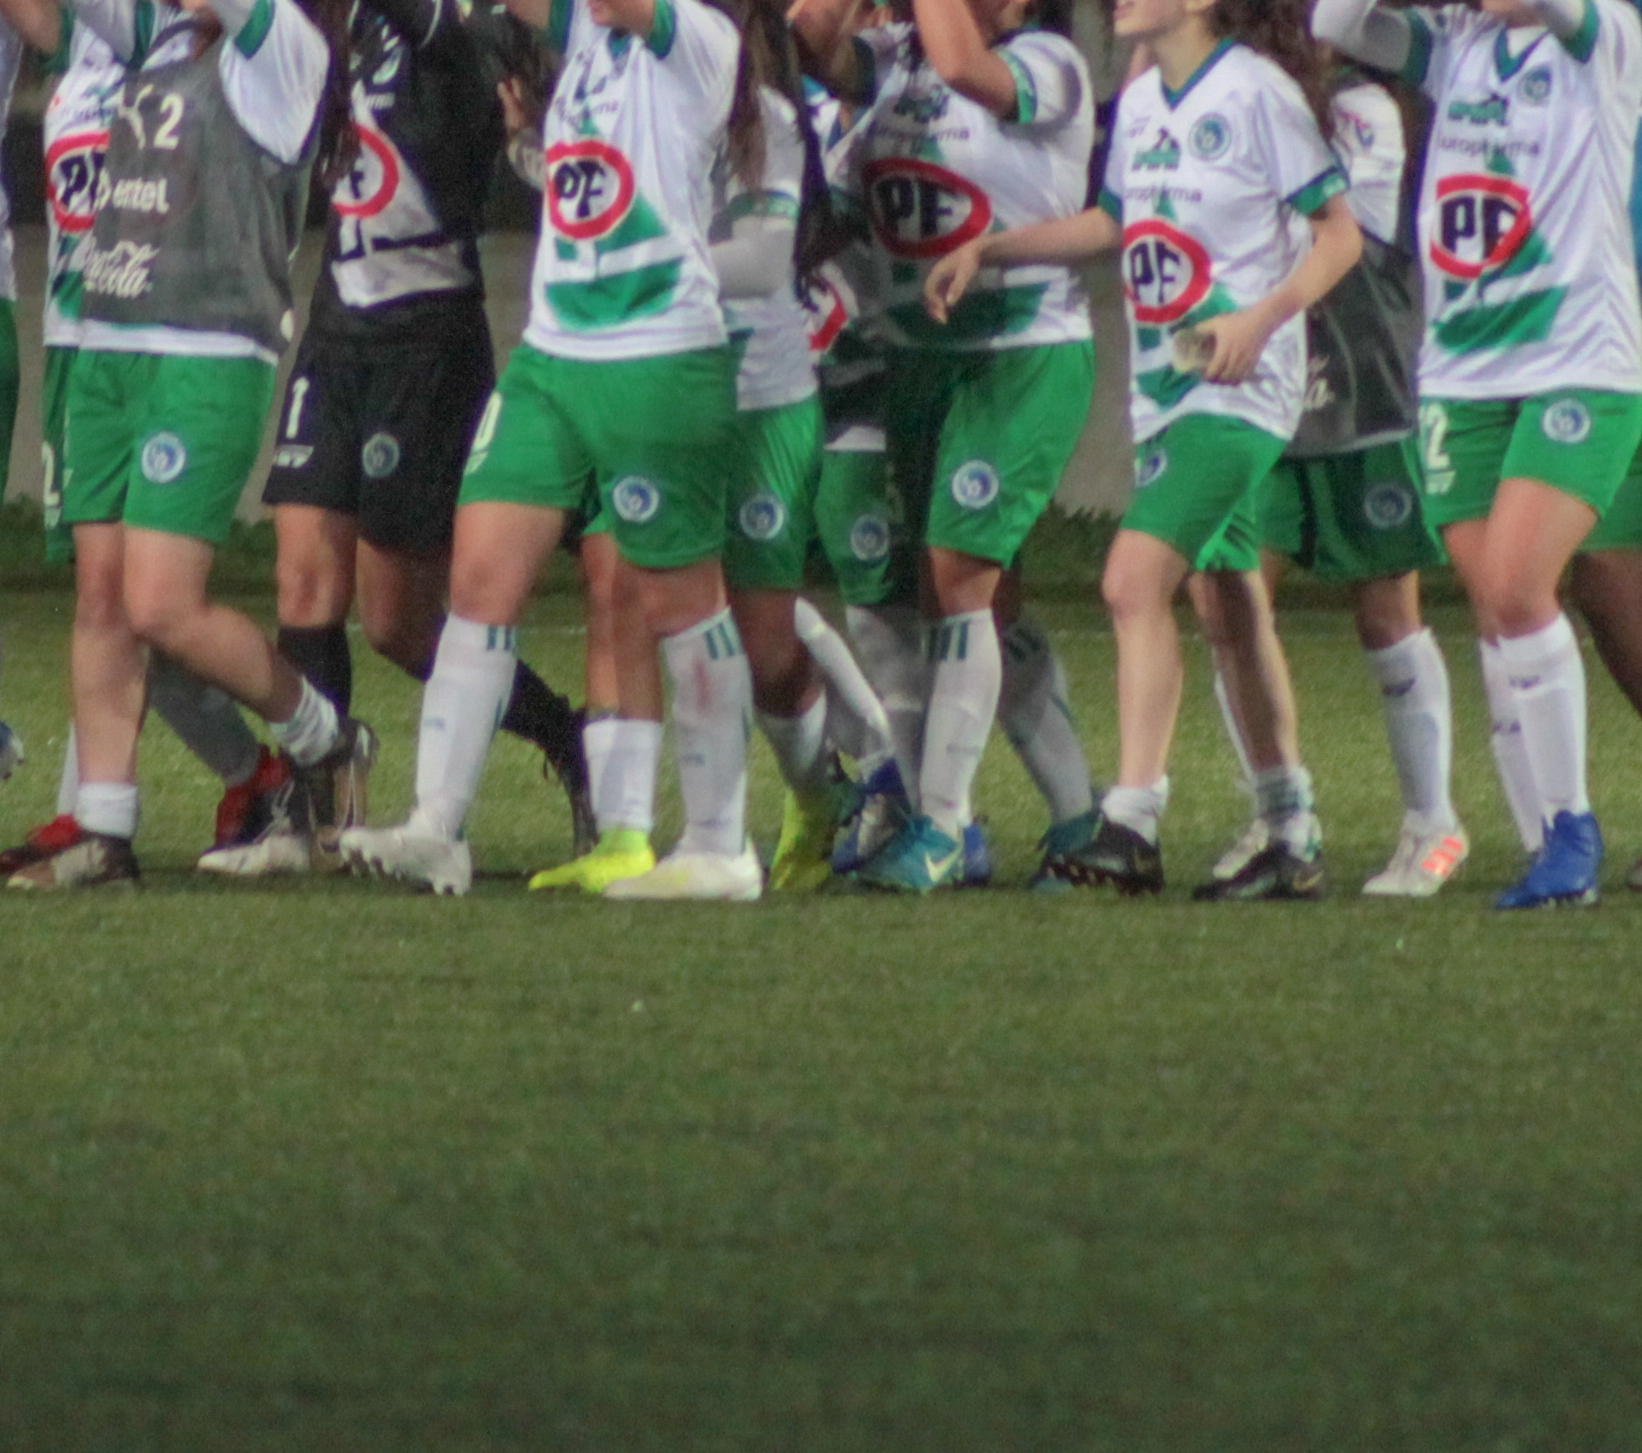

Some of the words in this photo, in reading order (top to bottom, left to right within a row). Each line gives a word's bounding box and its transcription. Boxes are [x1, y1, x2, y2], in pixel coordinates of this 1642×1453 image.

[153, 92, 184, 150] 2
[555, 159, 606, 219] PF
[877, 177, 957, 241] PF
[1441, 195, 1518, 260] PF
[1130, 240, 1180, 305] PF
[286, 377, 309, 439] 1
